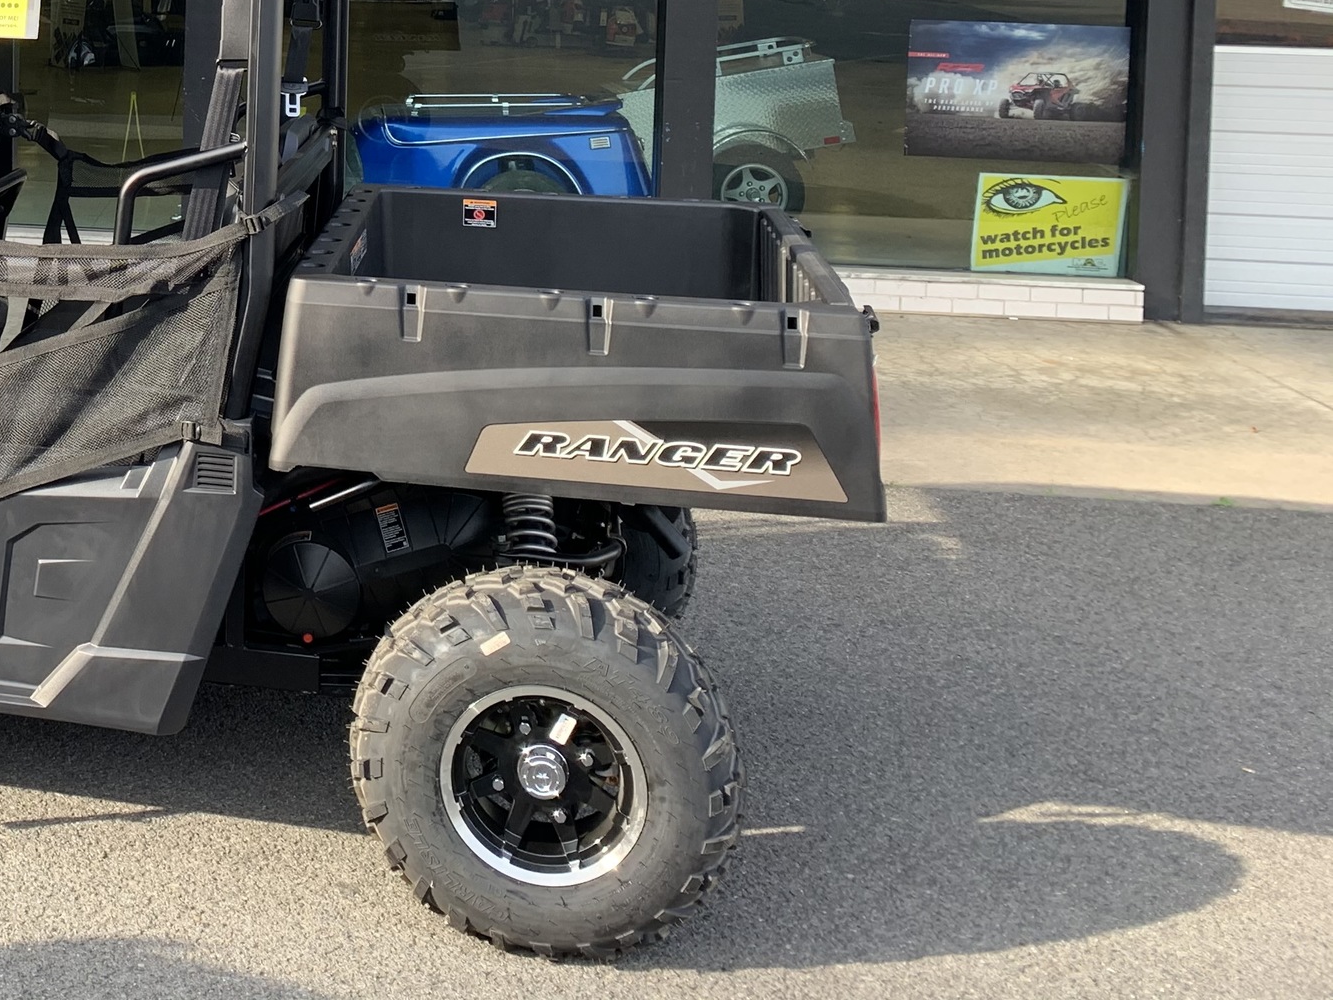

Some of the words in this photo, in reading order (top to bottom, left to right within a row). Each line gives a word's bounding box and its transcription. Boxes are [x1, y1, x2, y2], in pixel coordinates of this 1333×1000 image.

[924, 77, 964, 94] PRO
[972, 79, 998, 96] XP
[1051, 194, 1108, 222] Please
[980, 226, 1045, 246] watch
[1050, 224, 1082, 239] for
[981, 236, 1110, 260] motorcycles
[514, 430, 802, 476] RANGER
